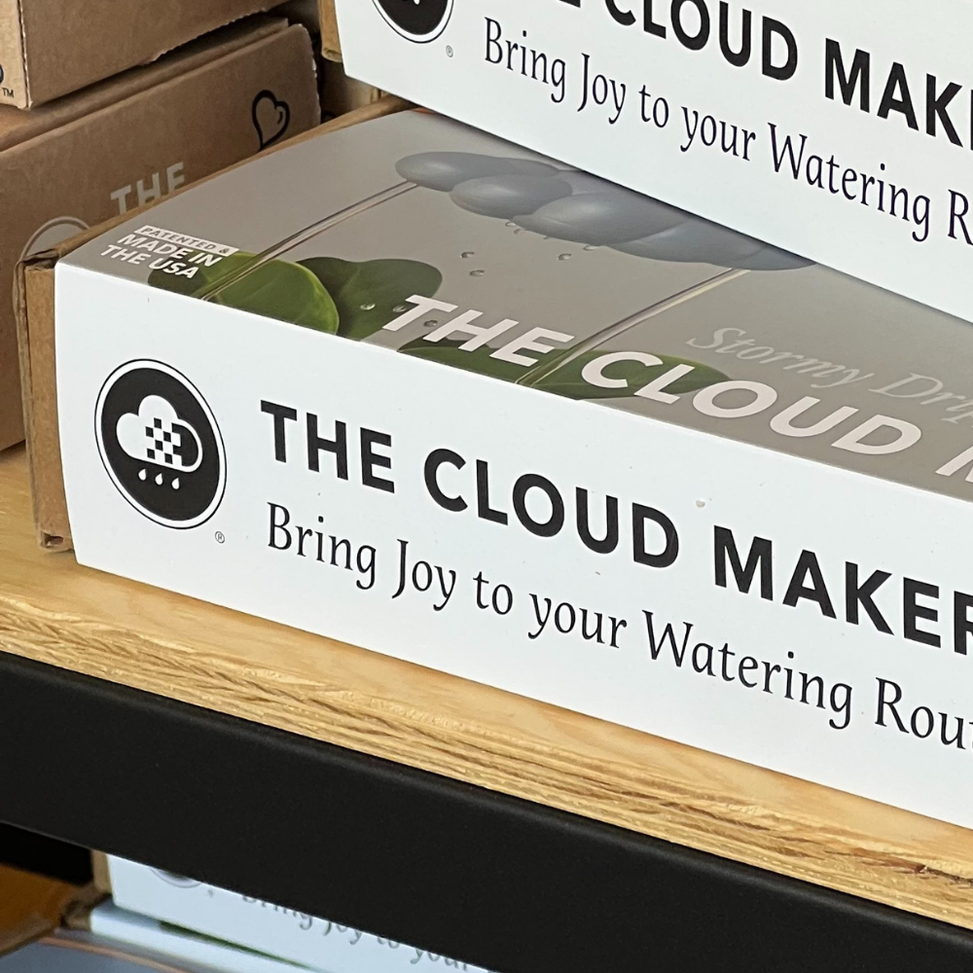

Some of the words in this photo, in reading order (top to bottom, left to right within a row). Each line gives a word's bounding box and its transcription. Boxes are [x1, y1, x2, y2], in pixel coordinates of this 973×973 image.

[484, 17, 566, 104] Bring
[577, 53, 626, 125] Joy
[639, 84, 670, 129] to
[680, 105, 756, 162] your
[767, 123, 930, 242] Watering
[100, 245, 151, 265] THE
[148, 257, 199, 279] USA
[117, 234, 194, 259] MADE
[188, 252, 222, 267] IN
[140, 227, 217, 251] PATENTED
[382, 294, 575, 367] THE
[581, 351, 921, 455] CLOUD
[686, 327, 874, 388] Stormy
[260, 399, 395, 493] THE
[423, 448, 680, 568] CLOUD
[267, 502, 376, 590] Bring
[392, 539, 456, 611] Joy
[472, 571, 513, 615] to
[528, 592, 627, 648] your
[642, 610, 852, 730] Watering
